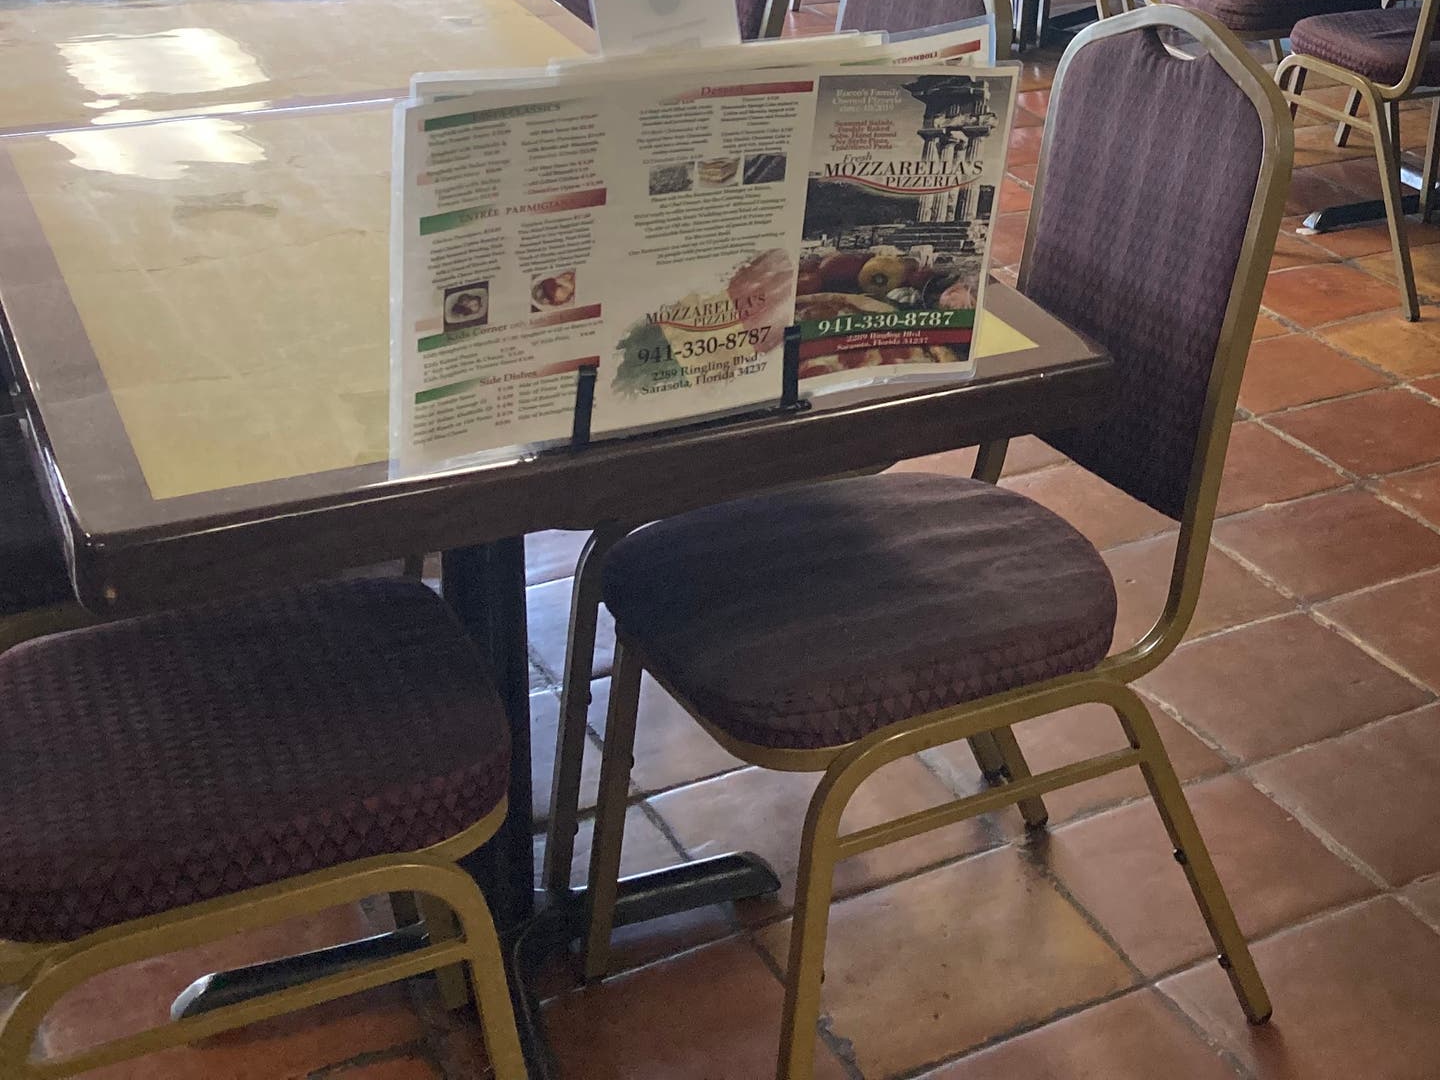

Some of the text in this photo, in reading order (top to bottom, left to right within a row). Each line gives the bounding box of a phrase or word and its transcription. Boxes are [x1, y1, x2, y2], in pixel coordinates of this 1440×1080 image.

[824, 160, 984, 177] MOZZARELLA'S
[843, 151, 872, 163] Fresh
[886, 175, 961, 188] PIZZERIA
[646, 293, 766, 324] MOZZARELLA'S
[818, 311, 954, 336] 941-330-8787
[638, 326, 771, 366] 941-330-8787
[480, 370, 538, 387] Side Dishes
[642, 361, 768, 395] Sarasota, Florida 34237
[653, 352, 758, 382] 2289 Ringling Blvd
